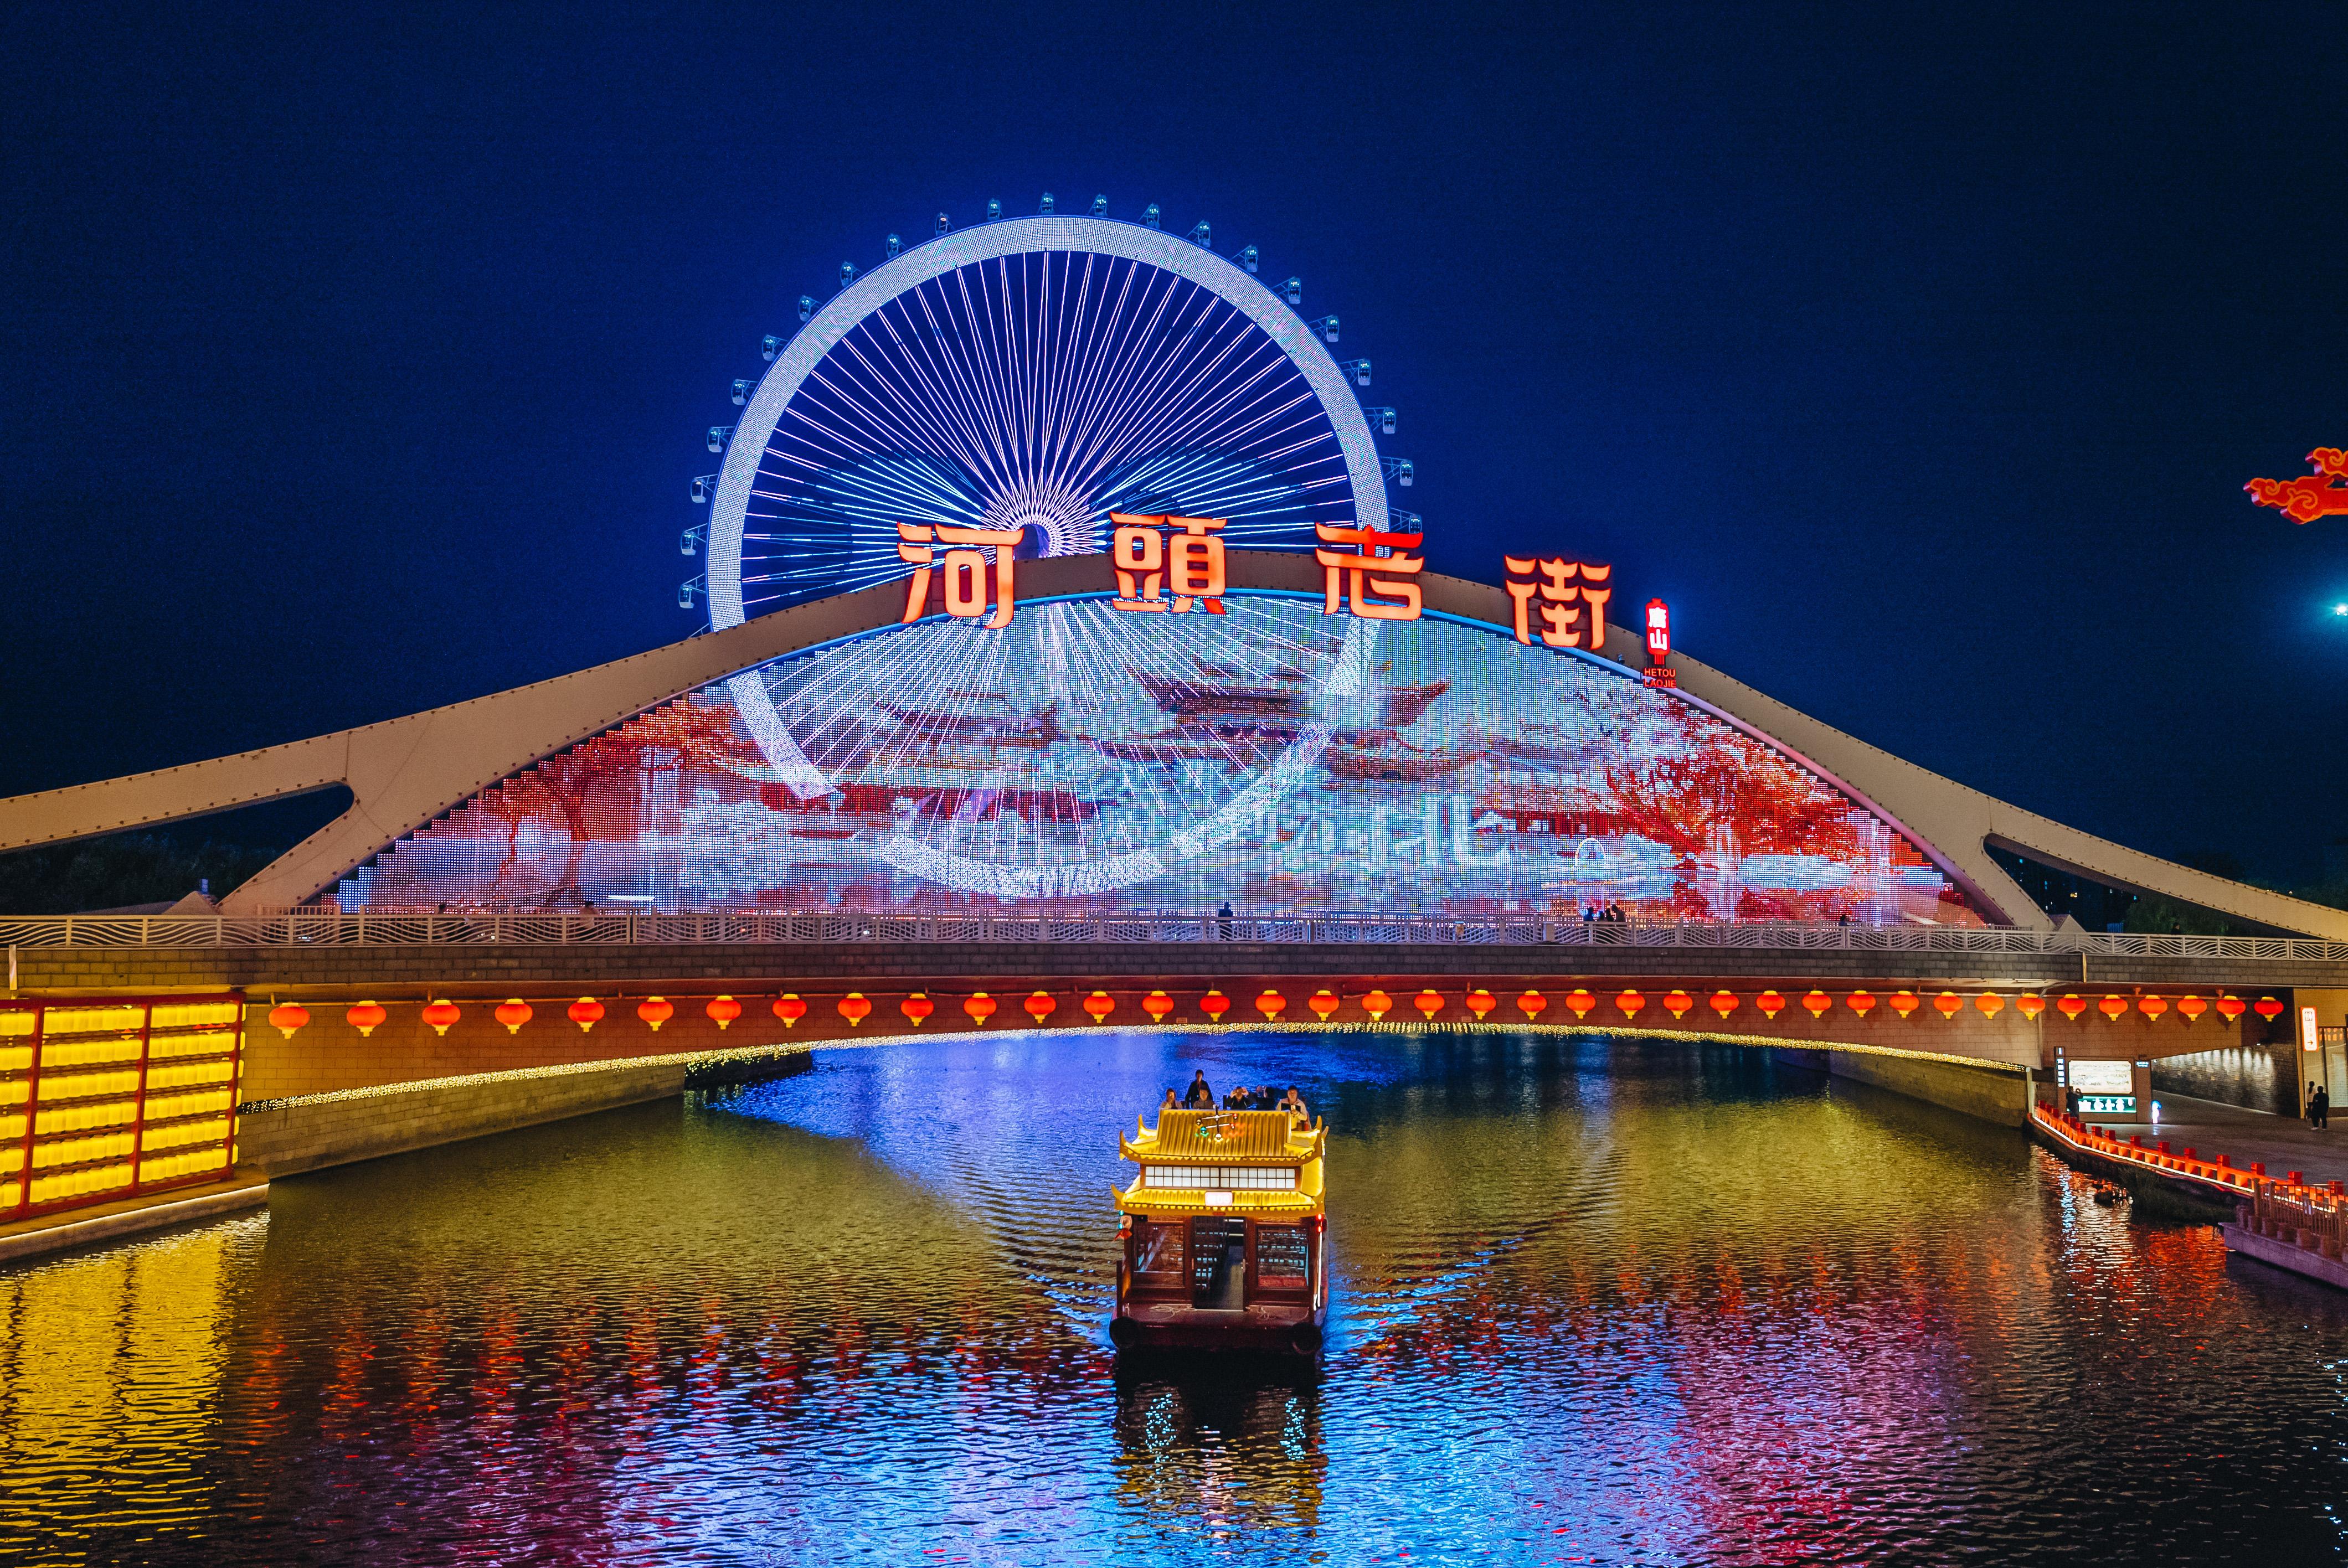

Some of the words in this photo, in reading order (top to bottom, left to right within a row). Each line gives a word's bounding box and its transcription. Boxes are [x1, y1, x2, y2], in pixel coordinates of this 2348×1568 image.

[1648, 607, 1667, 651] 唐山
[1644, 667, 1676, 677] HETOU
[1644, 679, 1676, 688] LAOJIE
